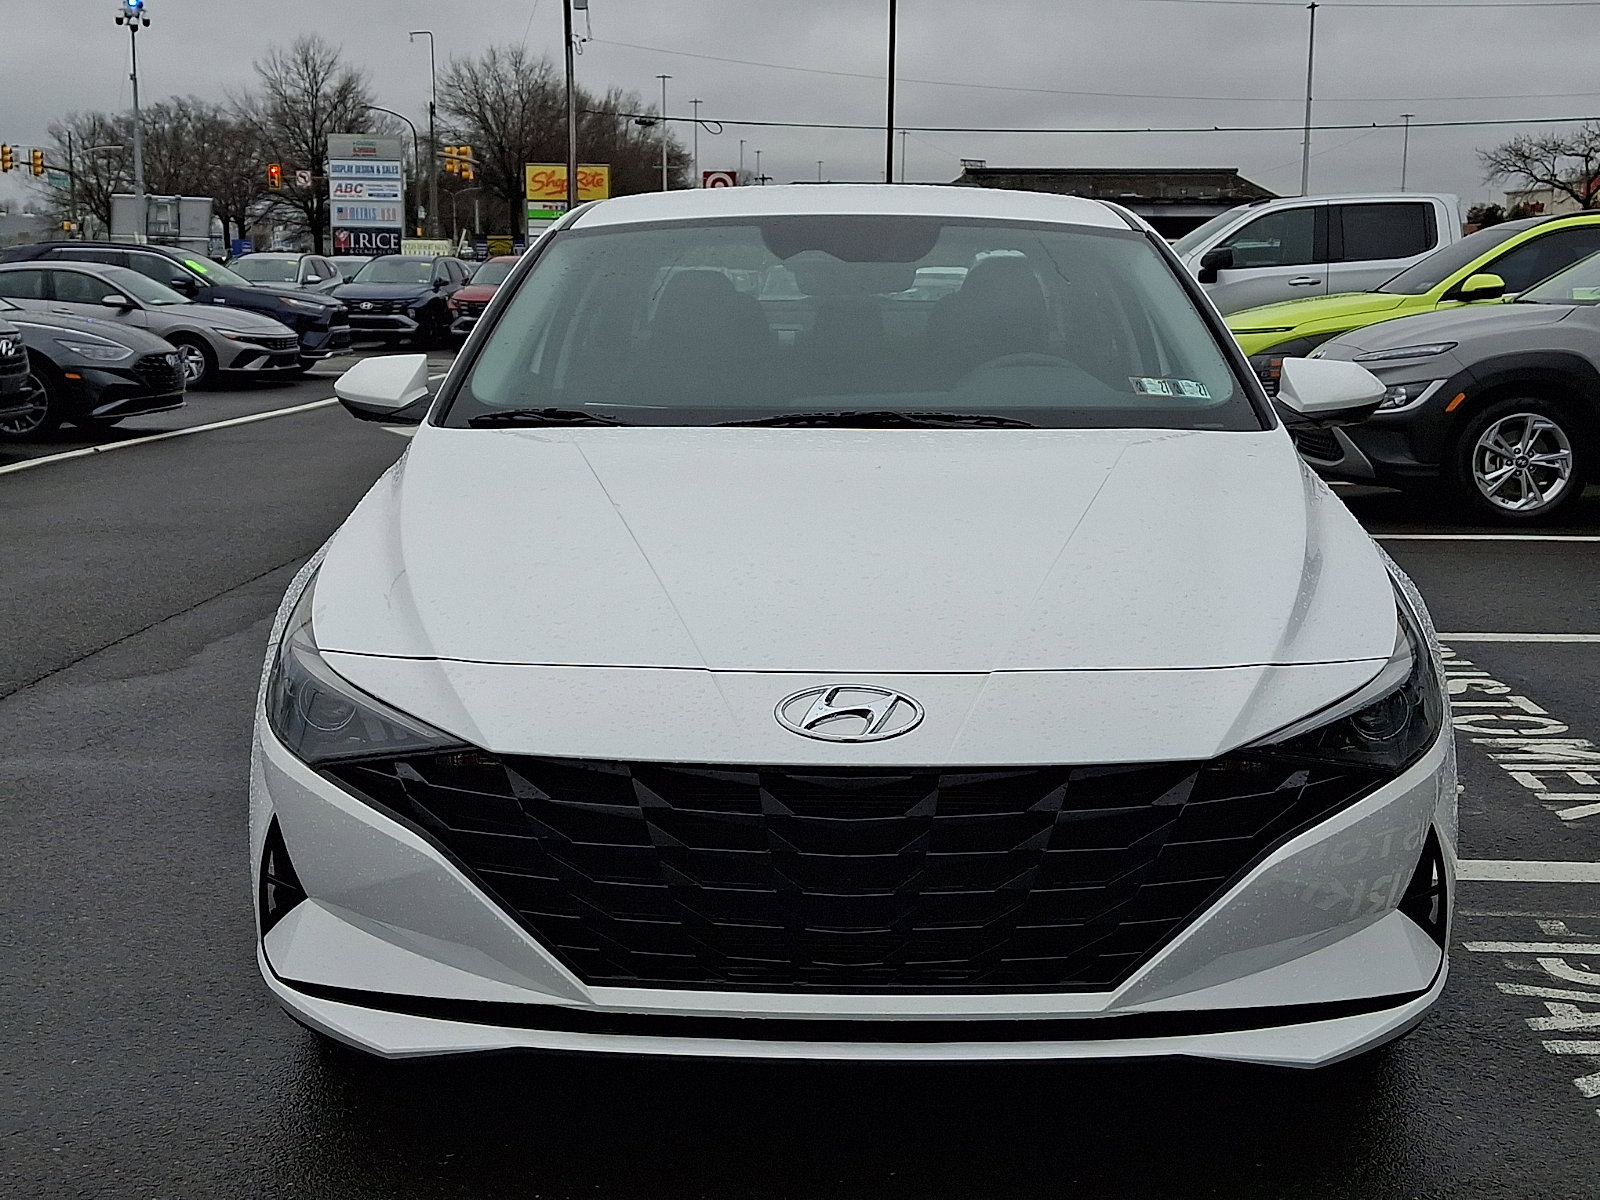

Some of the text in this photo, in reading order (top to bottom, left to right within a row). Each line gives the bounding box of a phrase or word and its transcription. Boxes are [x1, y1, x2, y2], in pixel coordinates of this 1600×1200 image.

[331, 164, 353, 173] DISPLAY
[382, 165, 399, 174] SALES
[334, 182, 364, 194] ABC
[350, 232, 399, 249] I.RICE
